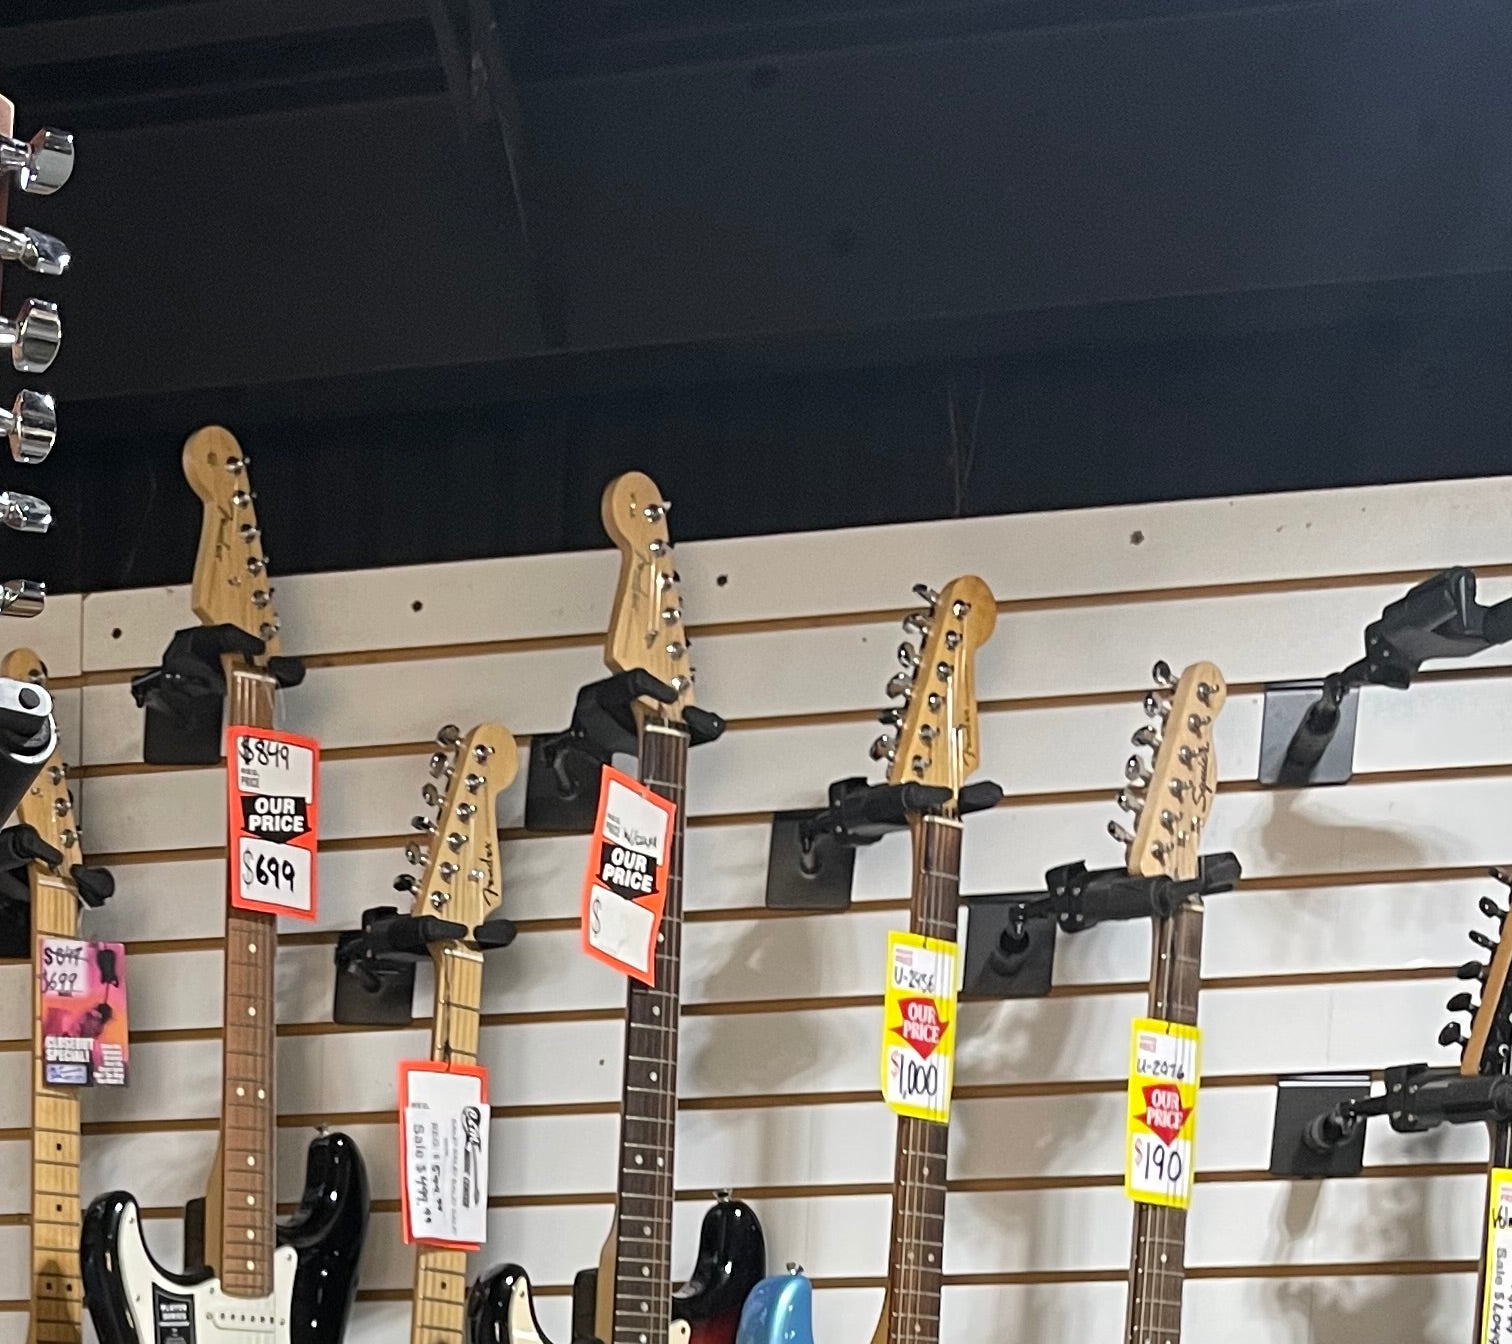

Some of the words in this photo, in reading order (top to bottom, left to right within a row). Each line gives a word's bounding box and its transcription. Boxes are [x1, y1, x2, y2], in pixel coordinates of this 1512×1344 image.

[239, 734, 290, 771] $849
[254, 797, 296, 815] OUR
[248, 814, 305, 833] PRICE
[242, 848, 296, 894] $699
[478, 841, 500, 907] Fender
[610, 847, 648, 873] OUR
[601, 863, 654, 893] PRICE
[907, 1002, 937, 1025] OUR
[902, 1019, 941, 1044] PRICE
[1151, 1088, 1180, 1110] OUR
[1146, 1106, 1184, 1130] PRICE
[413, 1124, 426, 1159] Sale
[1134, 1138, 1182, 1182] $190
[1494, 1247, 1507, 1286] Sale
